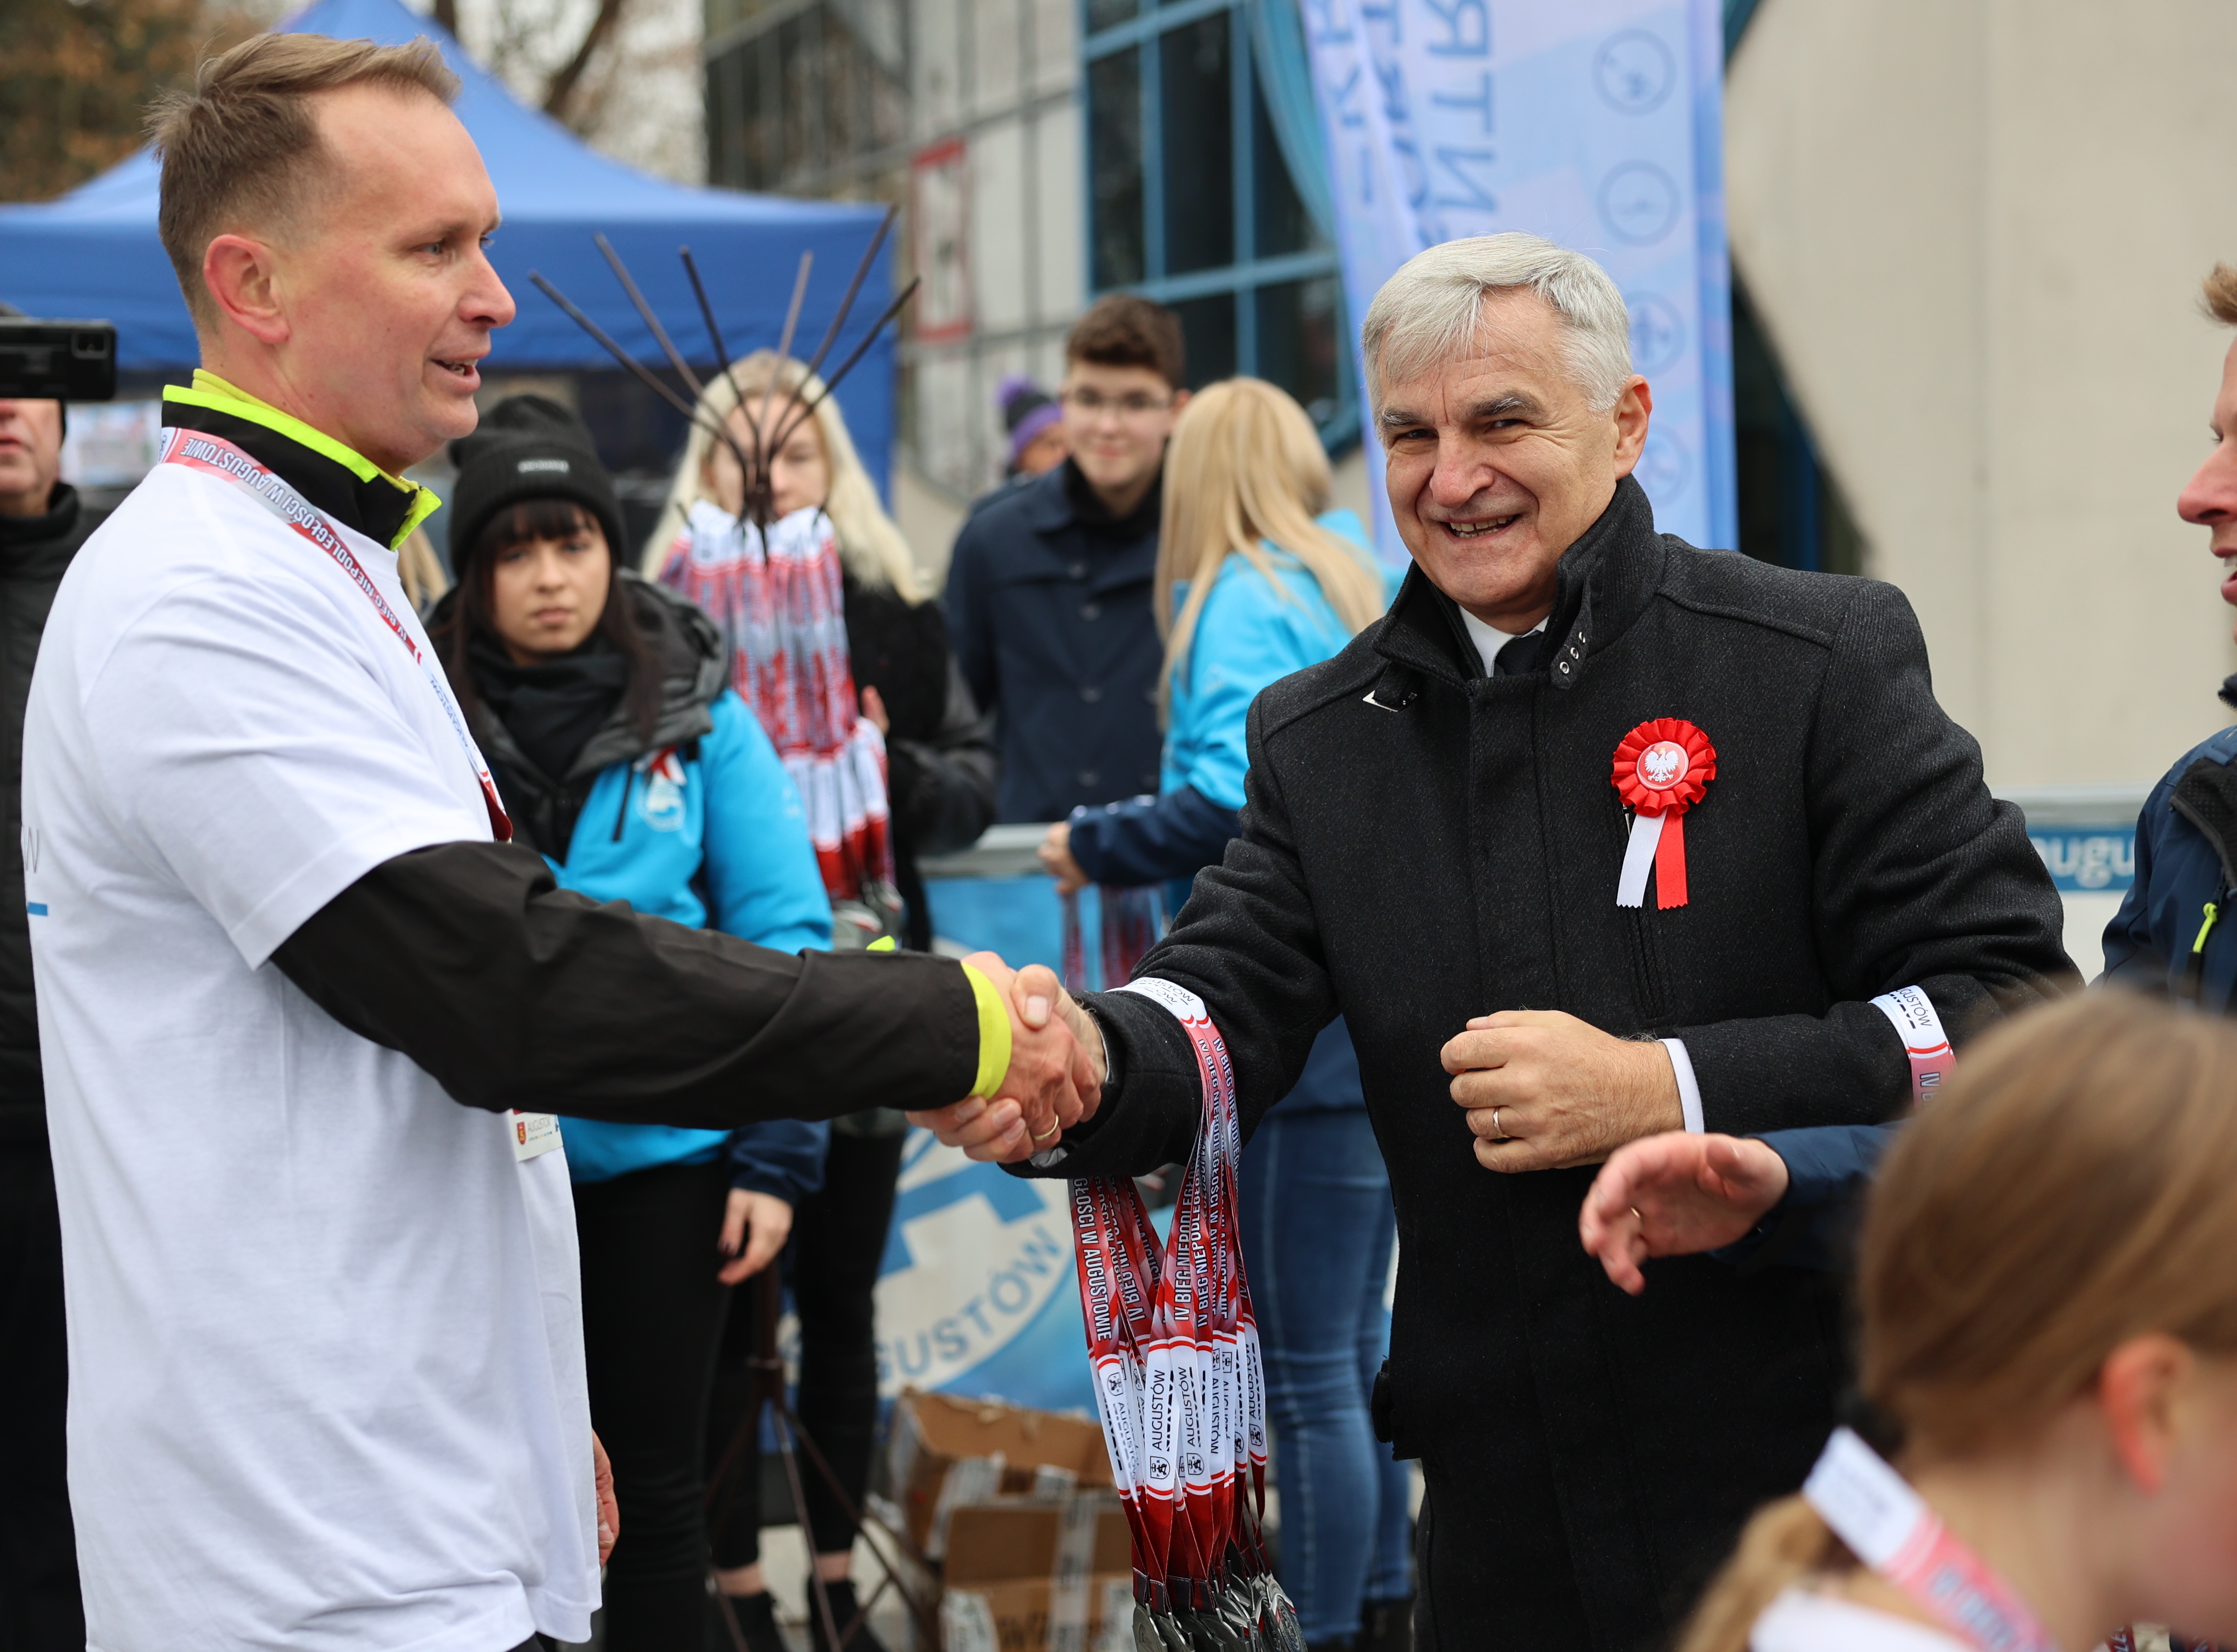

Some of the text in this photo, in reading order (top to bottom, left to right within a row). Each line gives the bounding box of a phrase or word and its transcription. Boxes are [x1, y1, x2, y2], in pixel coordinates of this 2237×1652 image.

[178, 437, 408, 642] IV BIEG NIEPODLEGŁOŚCI W AUGUSTOWIE
[1198, 1038, 1209, 1052] IV
[1205, 1055, 1219, 1088] BIEG
[1212, 1037, 1225, 1053] IV
[1220, 1052, 1233, 1088] BIEG
[1080, 1229, 1099, 1245] W
[1083, 1248, 1112, 1342] AUGUSTOWIE
[1122, 1270, 1147, 1322] IV BIEG
[1174, 1269, 1192, 1303] BIEG
[1196, 1276, 1209, 1310] BIEG
[1174, 1306, 1190, 1321] IV
[1197, 1312, 1208, 1328] IV
[1150, 1369, 1166, 1451] AUGUSTÓW
[1178, 1366, 1196, 1447] AUGUSTÓW
